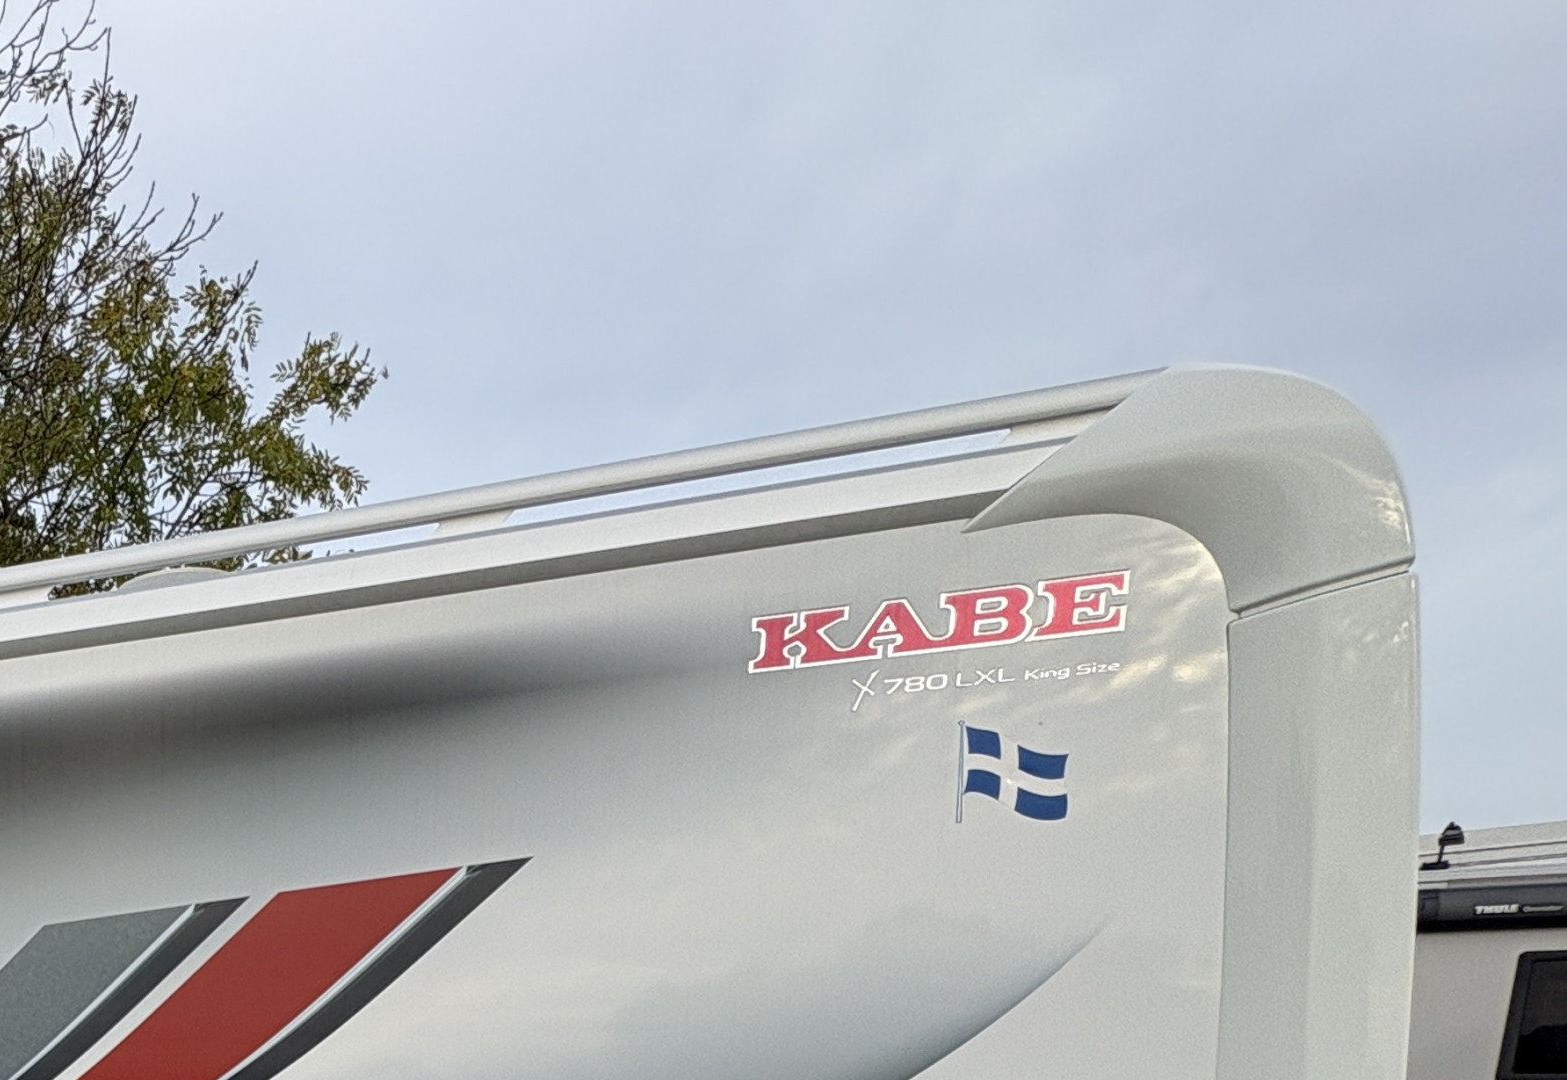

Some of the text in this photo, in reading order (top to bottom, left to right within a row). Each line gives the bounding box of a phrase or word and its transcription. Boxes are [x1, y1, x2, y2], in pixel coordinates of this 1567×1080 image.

[748, 569, 1130, 674] KABE
[884, 674, 948, 694] 780
[956, 668, 1015, 687] LXL
[1024, 667, 1070, 682] King
[1075, 659, 1120, 674] Size
